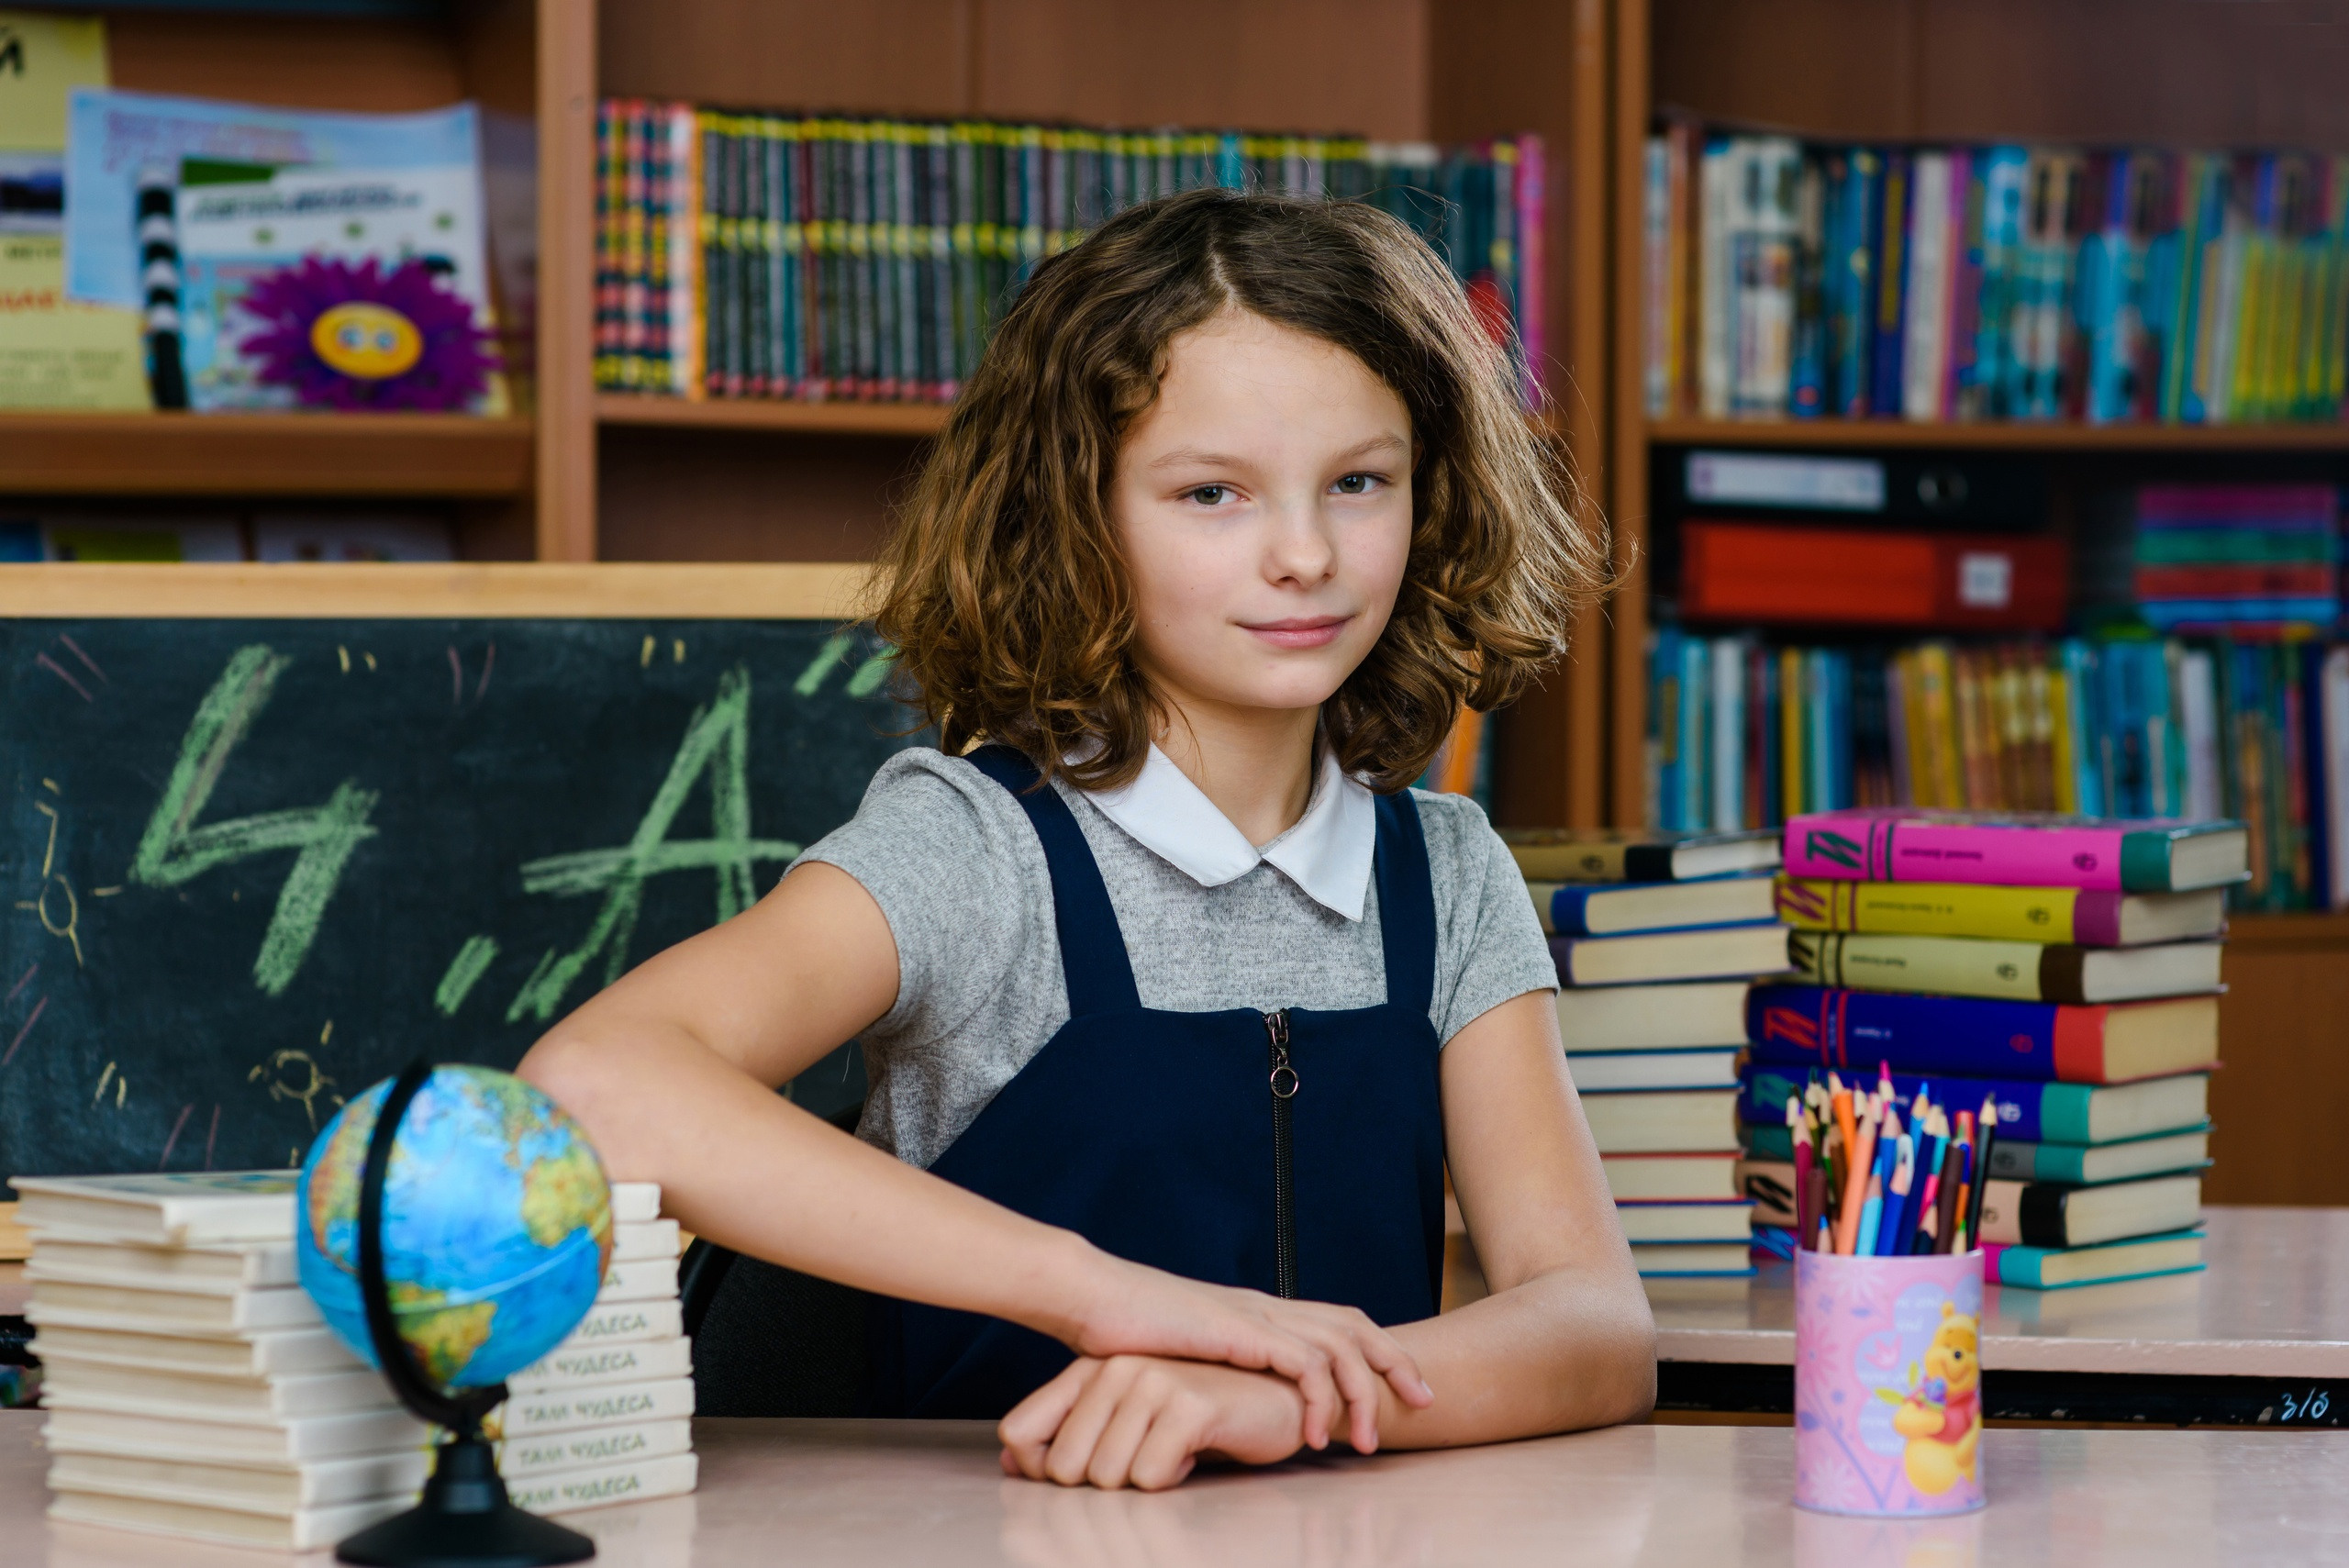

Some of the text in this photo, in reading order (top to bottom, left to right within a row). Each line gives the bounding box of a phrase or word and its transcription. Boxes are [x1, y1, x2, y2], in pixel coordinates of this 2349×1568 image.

[128, 644, 380, 995] 4
[578, 1313, 648, 1337] УДЕСА
[556, 1351, 637, 1375] ЧУДЕСА
[575, 1394, 654, 1418] ЧУДЕСА
[570, 1433, 646, 1457] ЧУДЕСА
[562, 1474, 640, 1499] ЧУДЕСА
